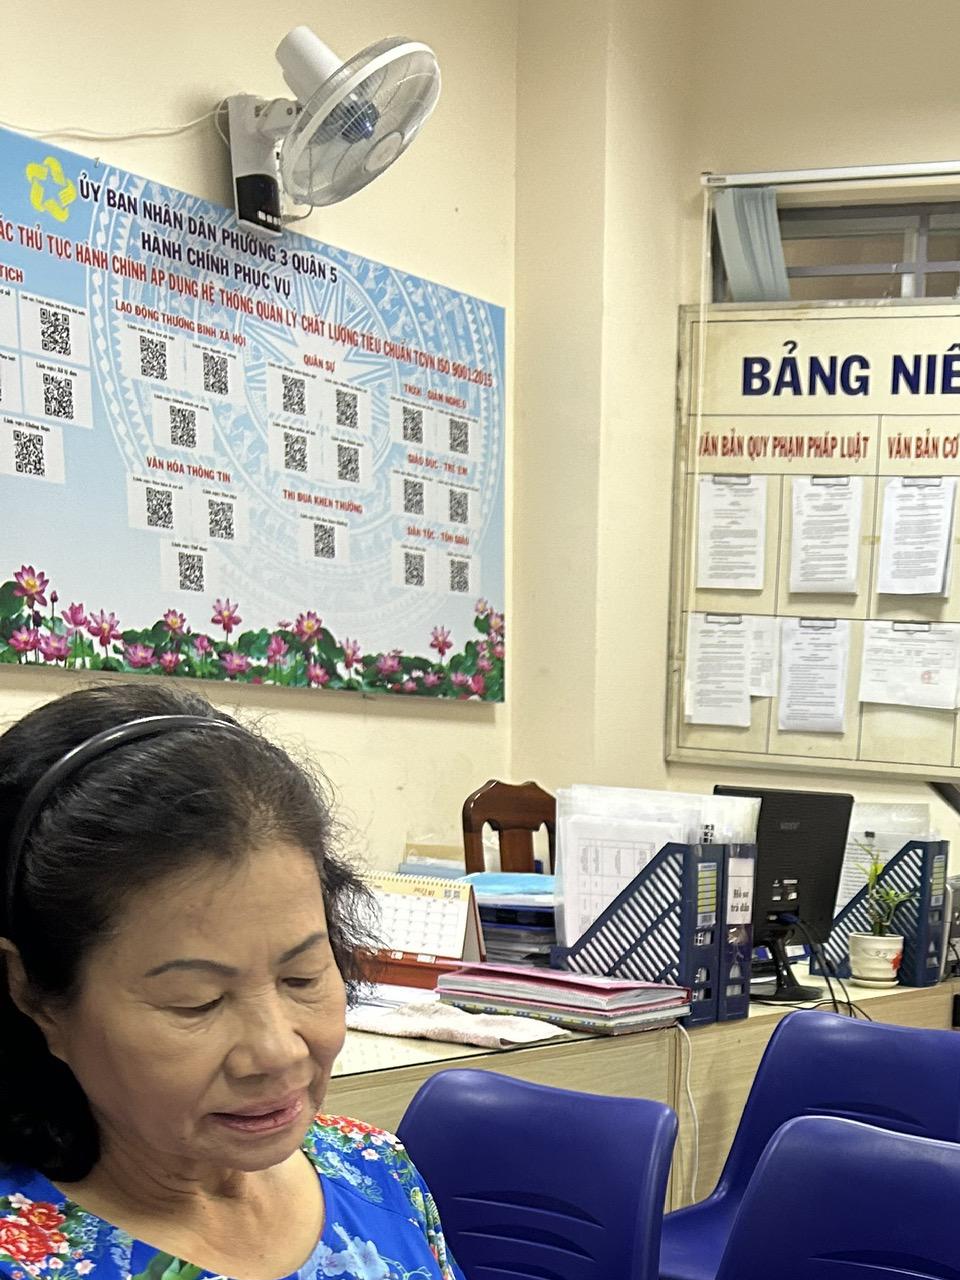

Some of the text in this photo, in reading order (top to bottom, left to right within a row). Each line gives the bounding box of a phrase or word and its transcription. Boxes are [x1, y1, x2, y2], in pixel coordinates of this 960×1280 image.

[80, 174, 101, 203] ỦY
[106, 189, 138, 216] BAN
[143, 202, 183, 231] NHÂN
[188, 215, 217, 242] DÂN
[280, 249, 288, 266] 3
[292, 255, 326, 281] QUẬN
[330, 267, 337, 283] 5
[18, 224, 42, 251] THỦ
[47, 235, 72, 261] TỤC
[75, 243, 108, 270] HÀNH
[112, 254, 147, 282] CHÍNH
[151, 265, 165, 287] ÁP
[168, 275, 199, 300] DỤNG
[201, 283, 215, 306] HỆ
[219, 288, 254, 314] THỐNG
[285, 309, 297, 328] LÝ
[301, 314, 325, 336] CHẤT
[141, 231, 291, 297] HÀNH CHÍNH PHỤC VỤ
[115, 299, 133, 314] LAO
[134, 304, 159, 321] ĐỘNG
[197, 324, 217, 337] BINH
[741, 340, 870, 396] BẢNG
[721, 427, 744, 457] BẢN
[747, 434, 769, 462] QUY
[771, 435, 804, 463] PHẠM
[806, 430, 837, 458] PHÁP
[840, 431, 870, 463] LUẬT
[888, 432, 912, 459] VĂN
[915, 428, 940, 459] BẢN
[943, 432, 960, 459] CƠ
